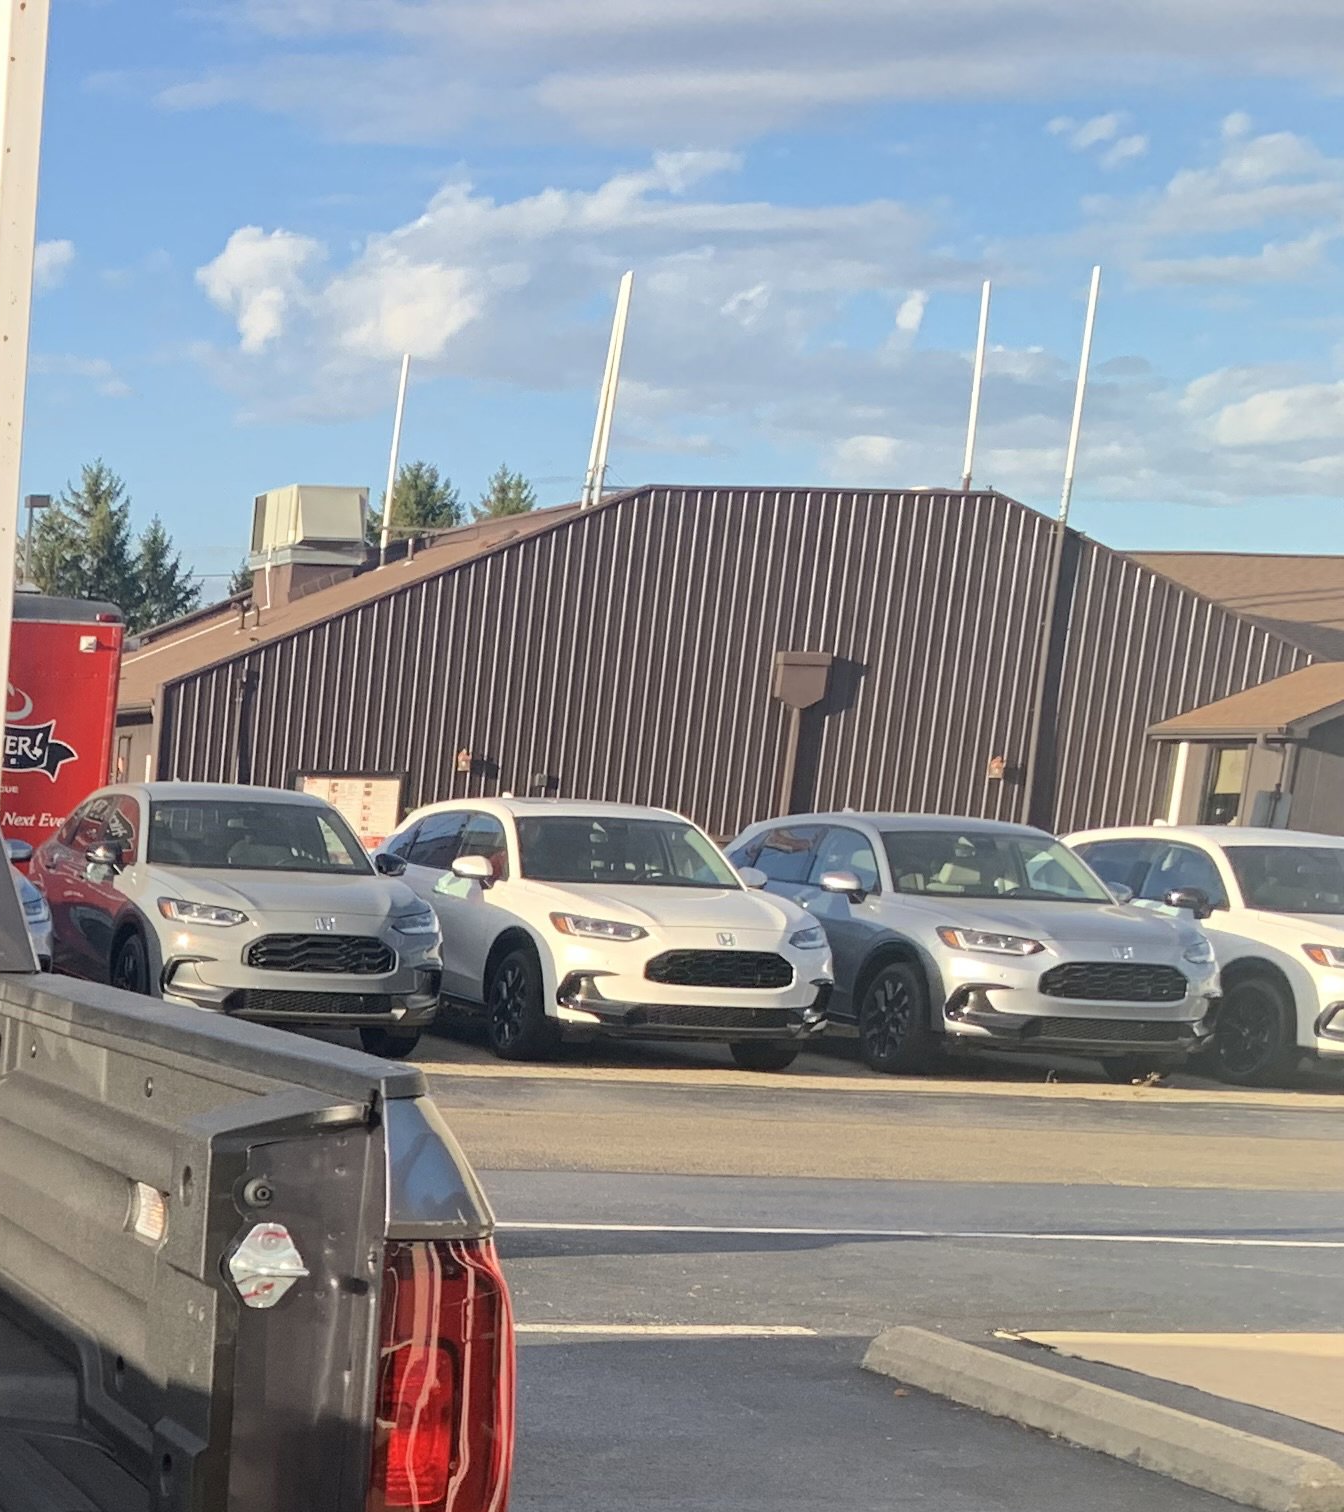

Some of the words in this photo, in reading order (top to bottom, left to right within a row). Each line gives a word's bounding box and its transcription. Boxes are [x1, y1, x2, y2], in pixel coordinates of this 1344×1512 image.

[3, 733, 44, 760] ER!
[1, 812, 36, 827] Next
[38, 813, 67, 828] Eve
